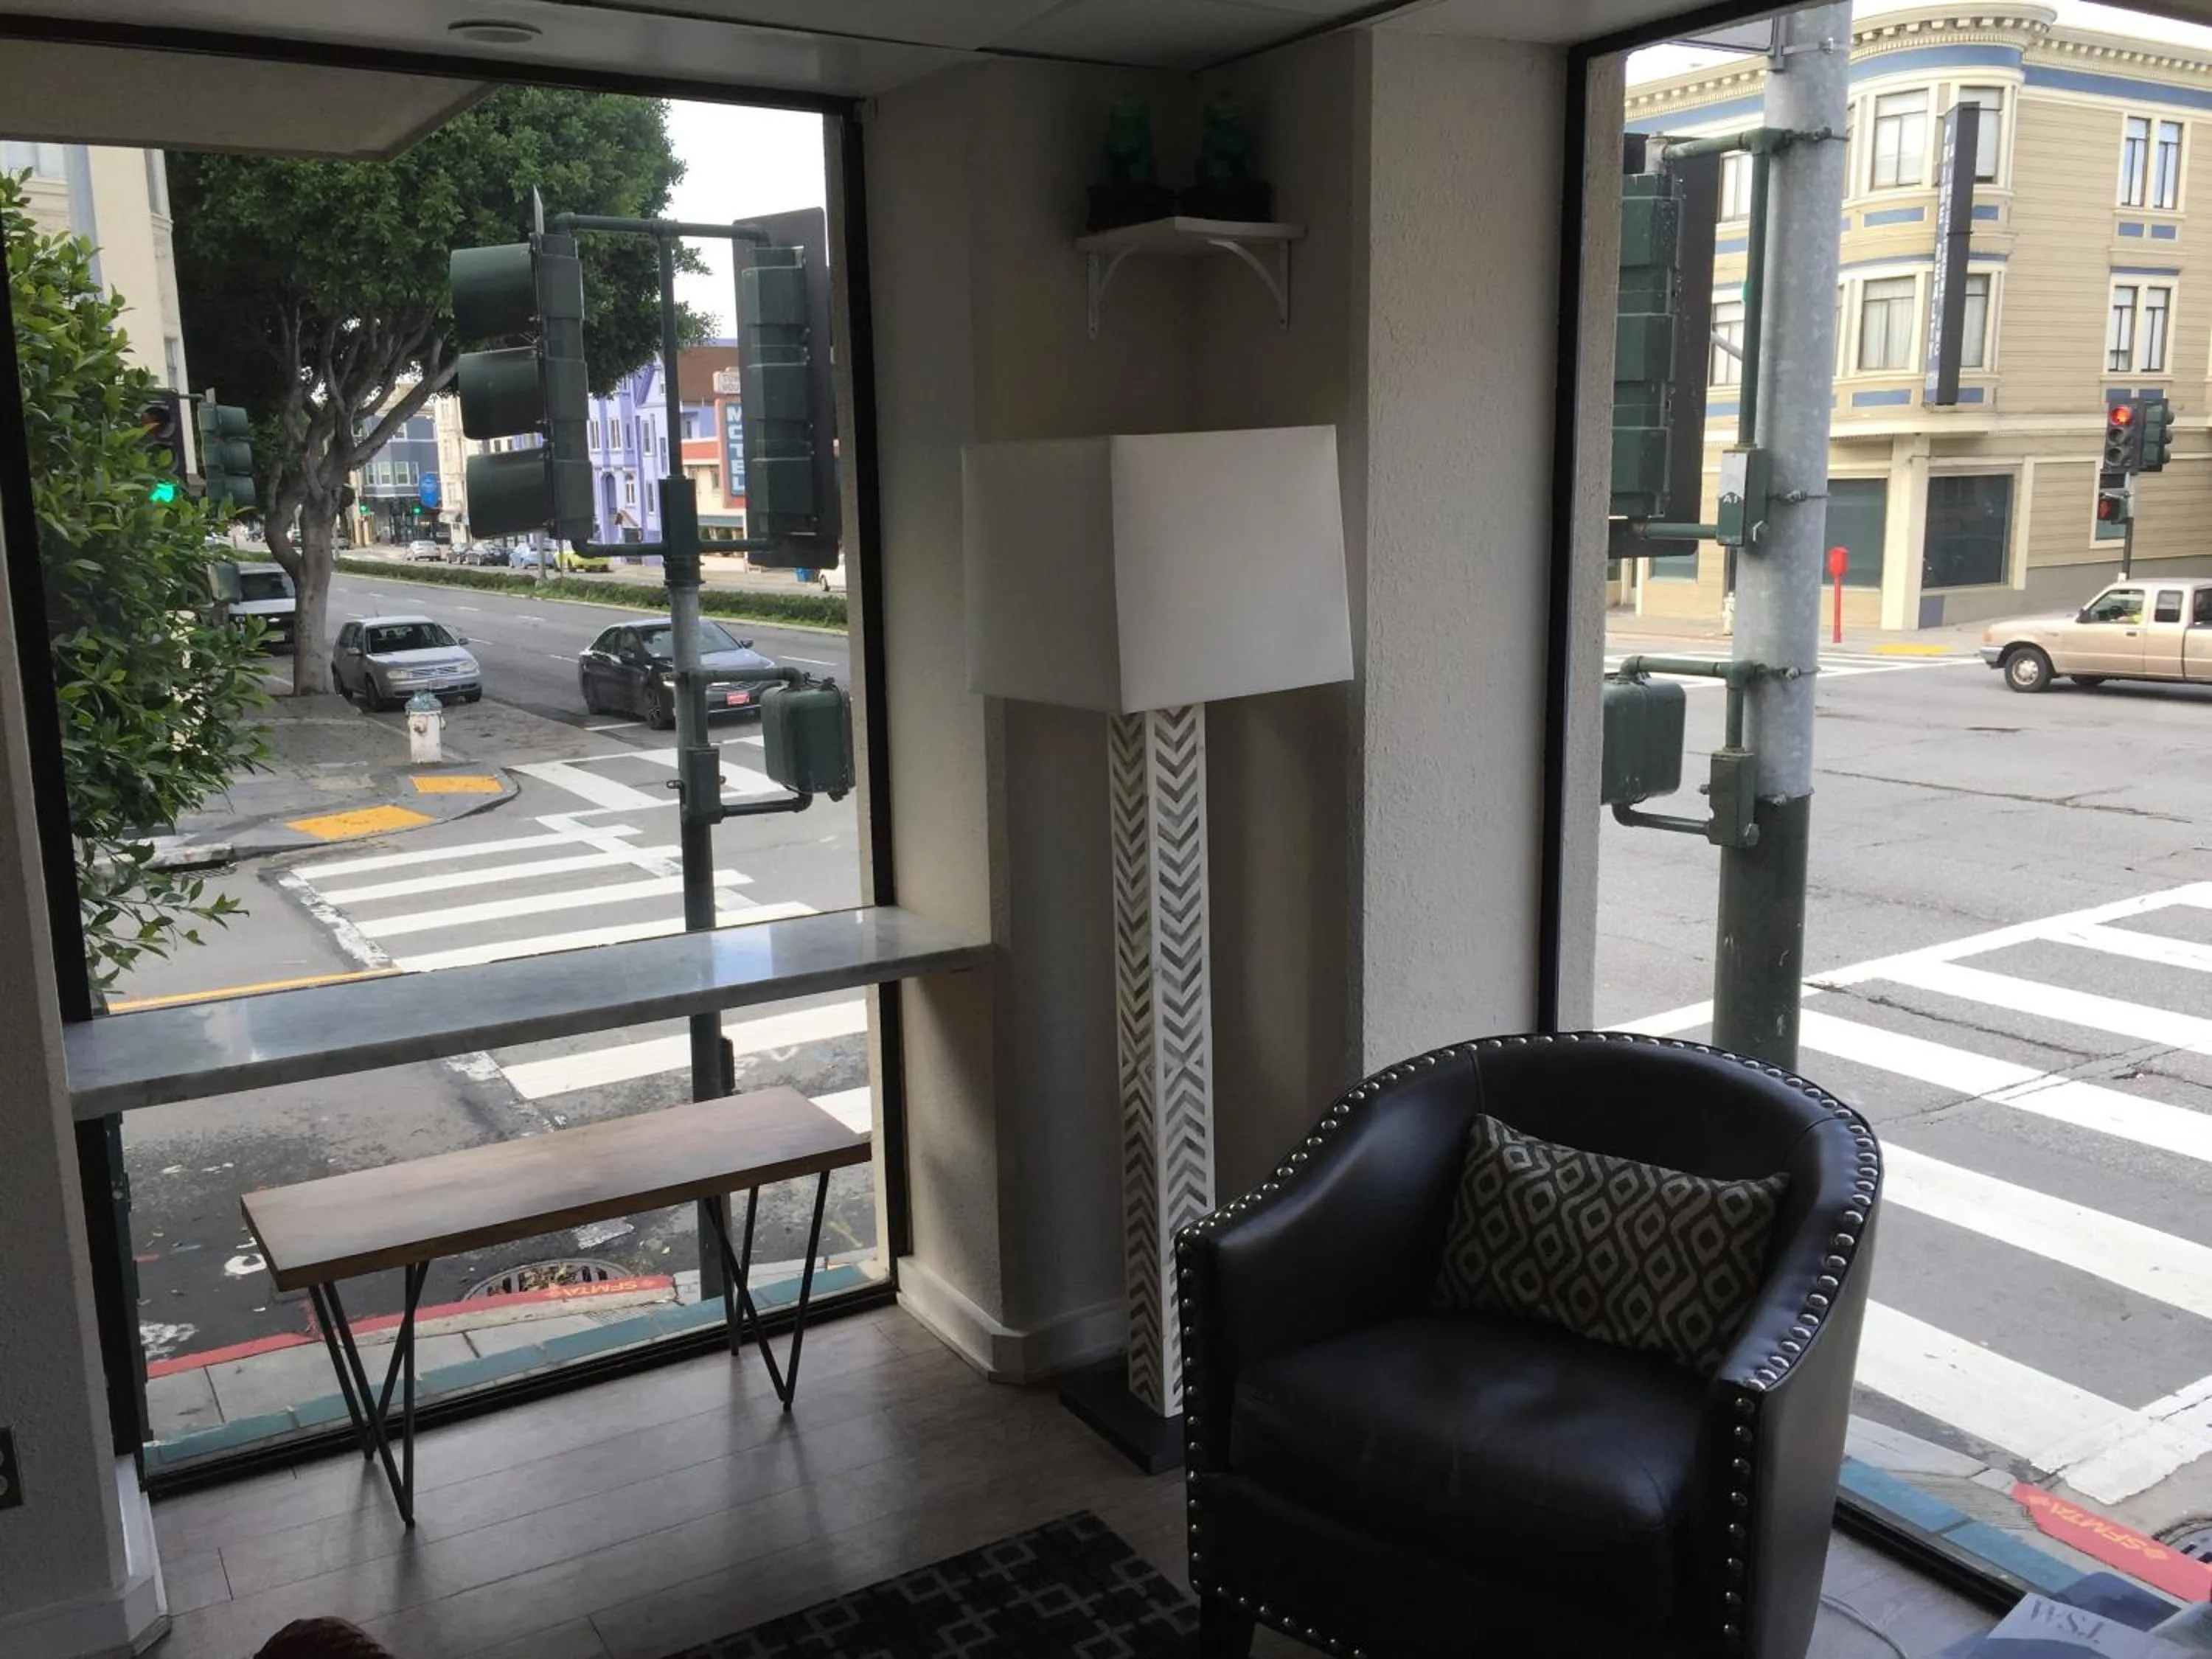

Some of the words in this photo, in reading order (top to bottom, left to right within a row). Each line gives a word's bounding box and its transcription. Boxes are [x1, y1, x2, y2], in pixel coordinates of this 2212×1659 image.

[1927, 242, 1942, 358] REALTY
[563, 1281, 638, 1298] SFMTA
[2050, 1502, 2148, 1550] SFMTA
